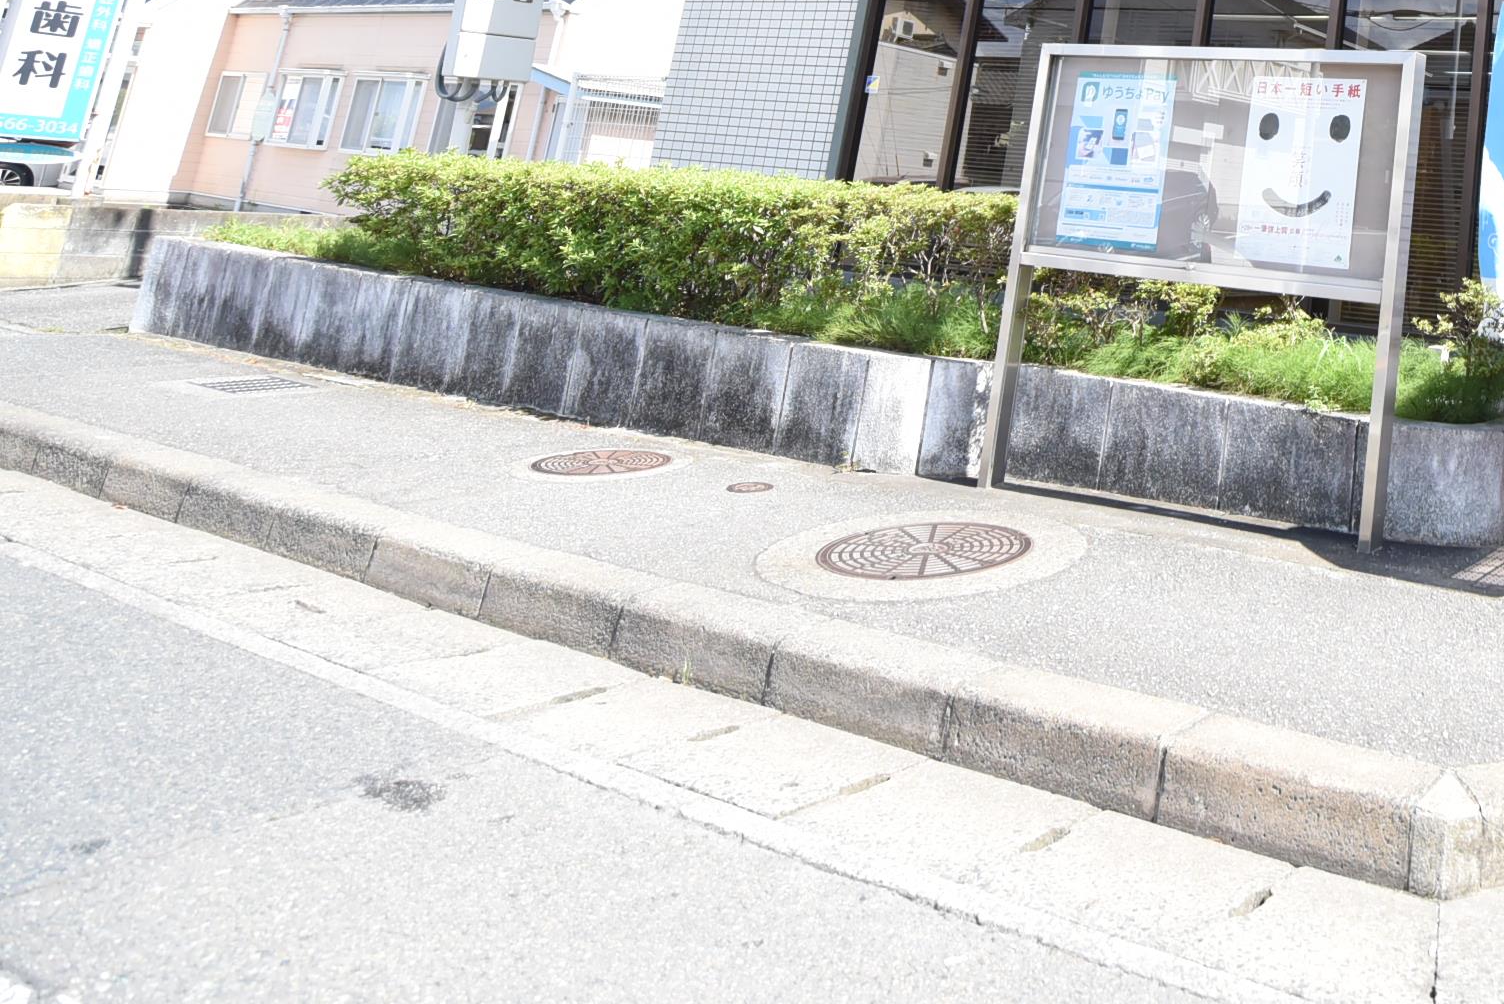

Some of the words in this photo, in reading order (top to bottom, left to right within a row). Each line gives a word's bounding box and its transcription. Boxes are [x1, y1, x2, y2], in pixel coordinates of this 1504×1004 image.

[1257, 81, 1361, 98] 日本一短い手紙
